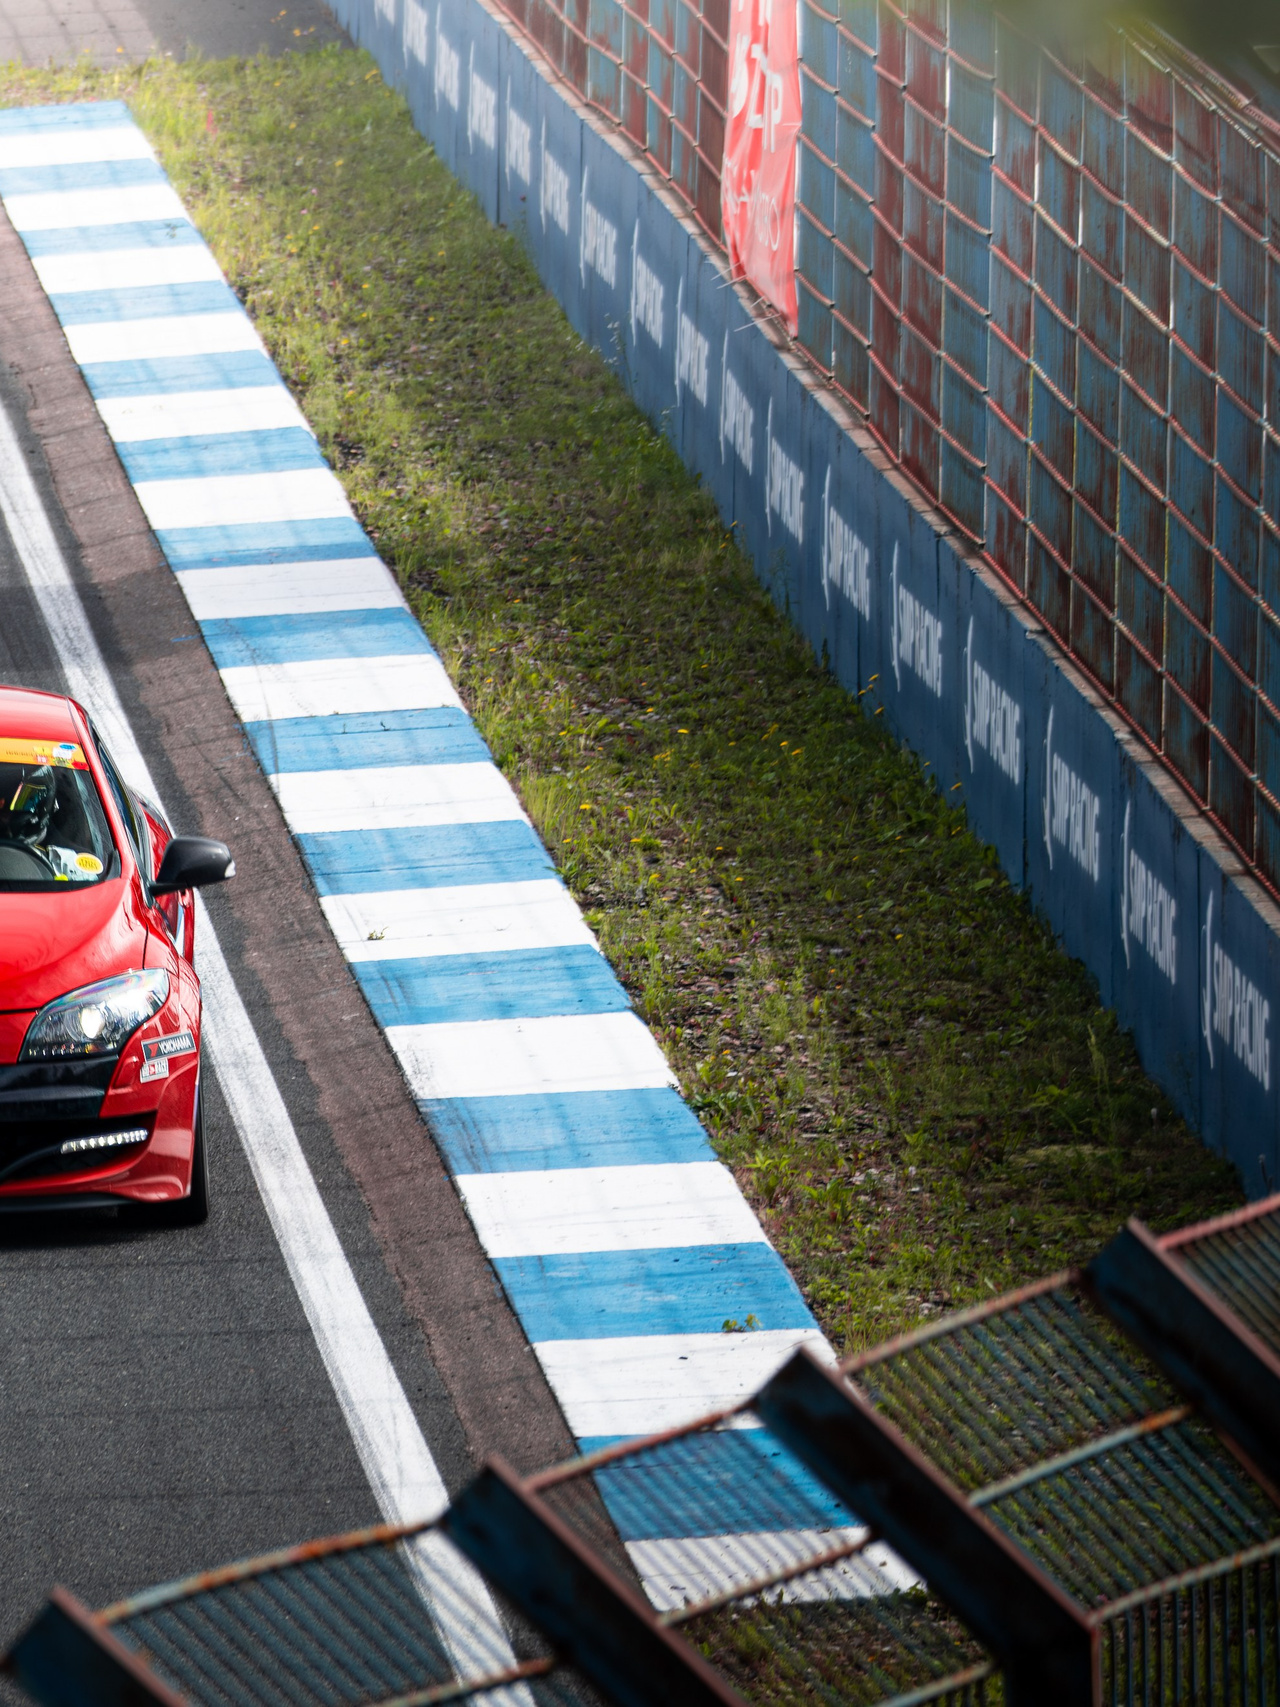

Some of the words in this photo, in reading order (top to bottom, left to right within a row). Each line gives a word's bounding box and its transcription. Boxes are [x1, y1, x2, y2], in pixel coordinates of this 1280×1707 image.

[973, 661, 990, 750] SMP
[990, 679, 1020, 785] RACING
[1052, 752, 1069, 846] SMP
[1069, 771, 1100, 882] RACING
[1129, 848, 1146, 944] SMP
[1146, 870, 1177, 985] RACING
[158, 1034, 192, 1055] YOKOHAMA
[1213, 942, 1233, 1045] SMP
[1233, 965, 1270, 1092] RACING
